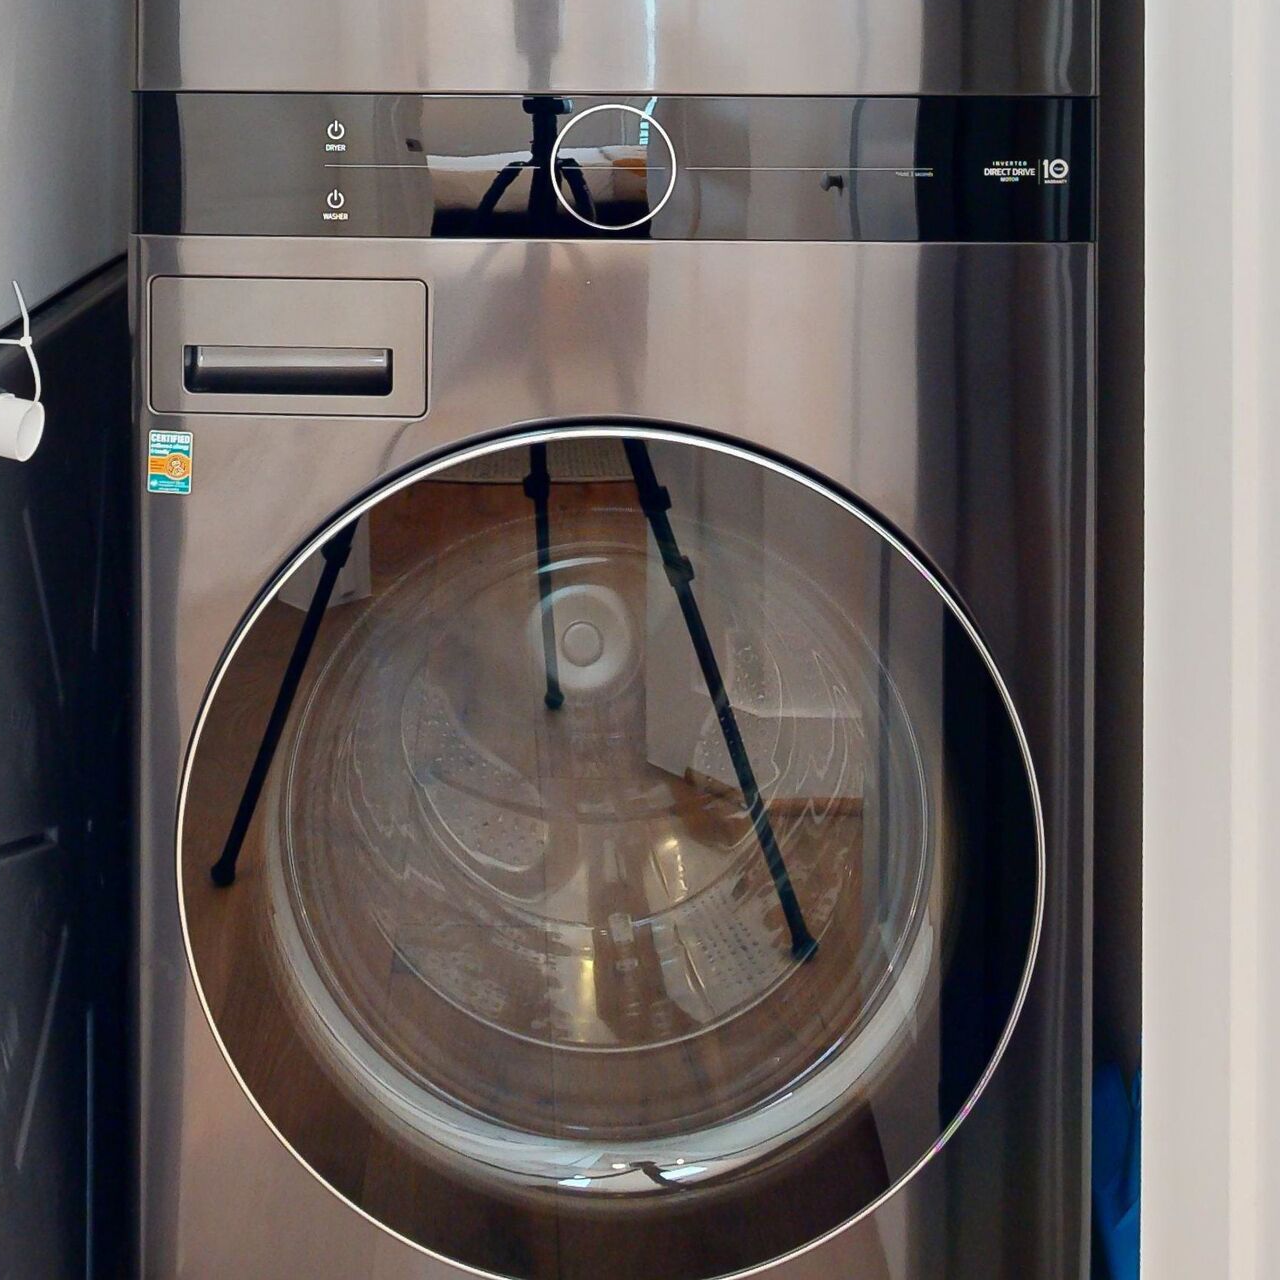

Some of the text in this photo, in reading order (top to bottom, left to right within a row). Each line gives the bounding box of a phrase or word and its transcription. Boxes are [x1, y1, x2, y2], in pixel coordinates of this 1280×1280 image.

[325, 143, 346, 152] DRYER
[983, 167, 1036, 176] DIRECT DRIVE
[1042, 158, 1069, 179] 10
[322, 212, 349, 220] WASHER
[151, 433, 190, 443] CERTIFIED
